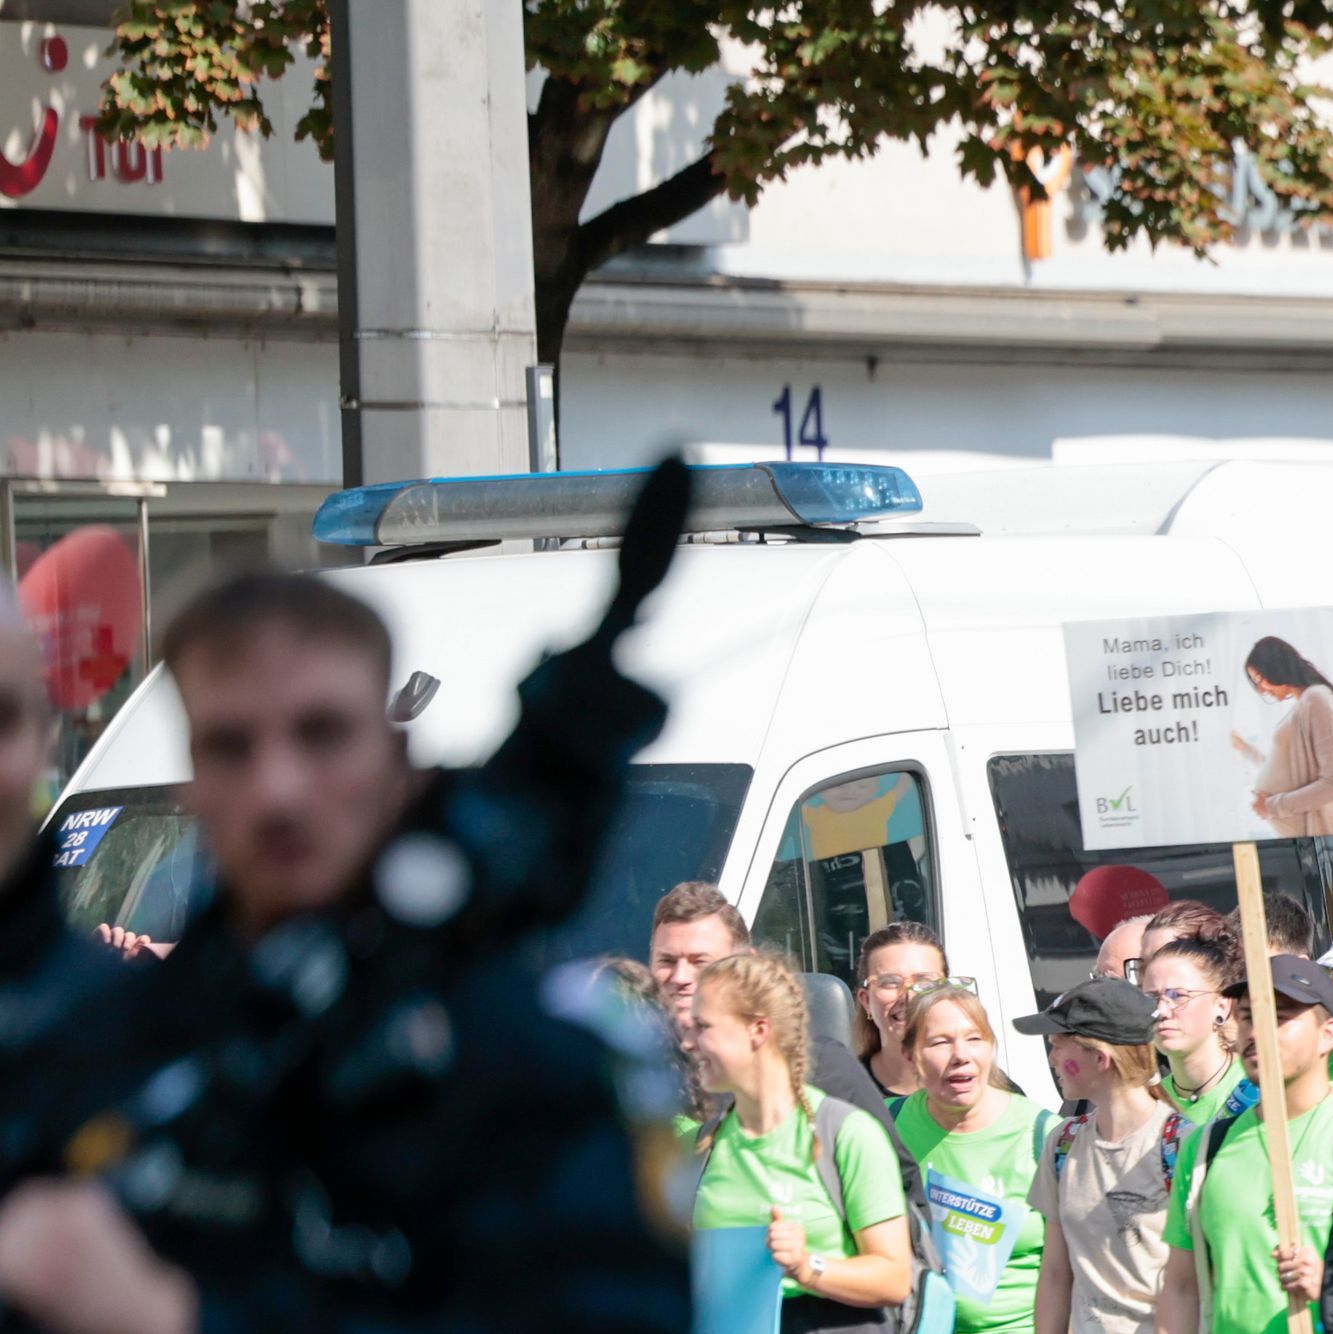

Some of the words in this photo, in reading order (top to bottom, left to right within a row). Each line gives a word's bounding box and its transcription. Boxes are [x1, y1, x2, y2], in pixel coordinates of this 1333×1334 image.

[773, 384, 828, 460] 14
[1103, 637, 1169, 654] Mama,
[1175, 633, 1205, 649] ich
[1107, 665, 1155, 681] liebe
[1161, 659, 1212, 678] Dich!
[1099, 689, 1164, 714] Liebe
[1172, 685, 1229, 710] mich
[1134, 721, 1200, 746] auch!
[61, 808, 120, 832] NRW
[61, 831, 89, 849] 28
[53, 848, 86, 867] AT
